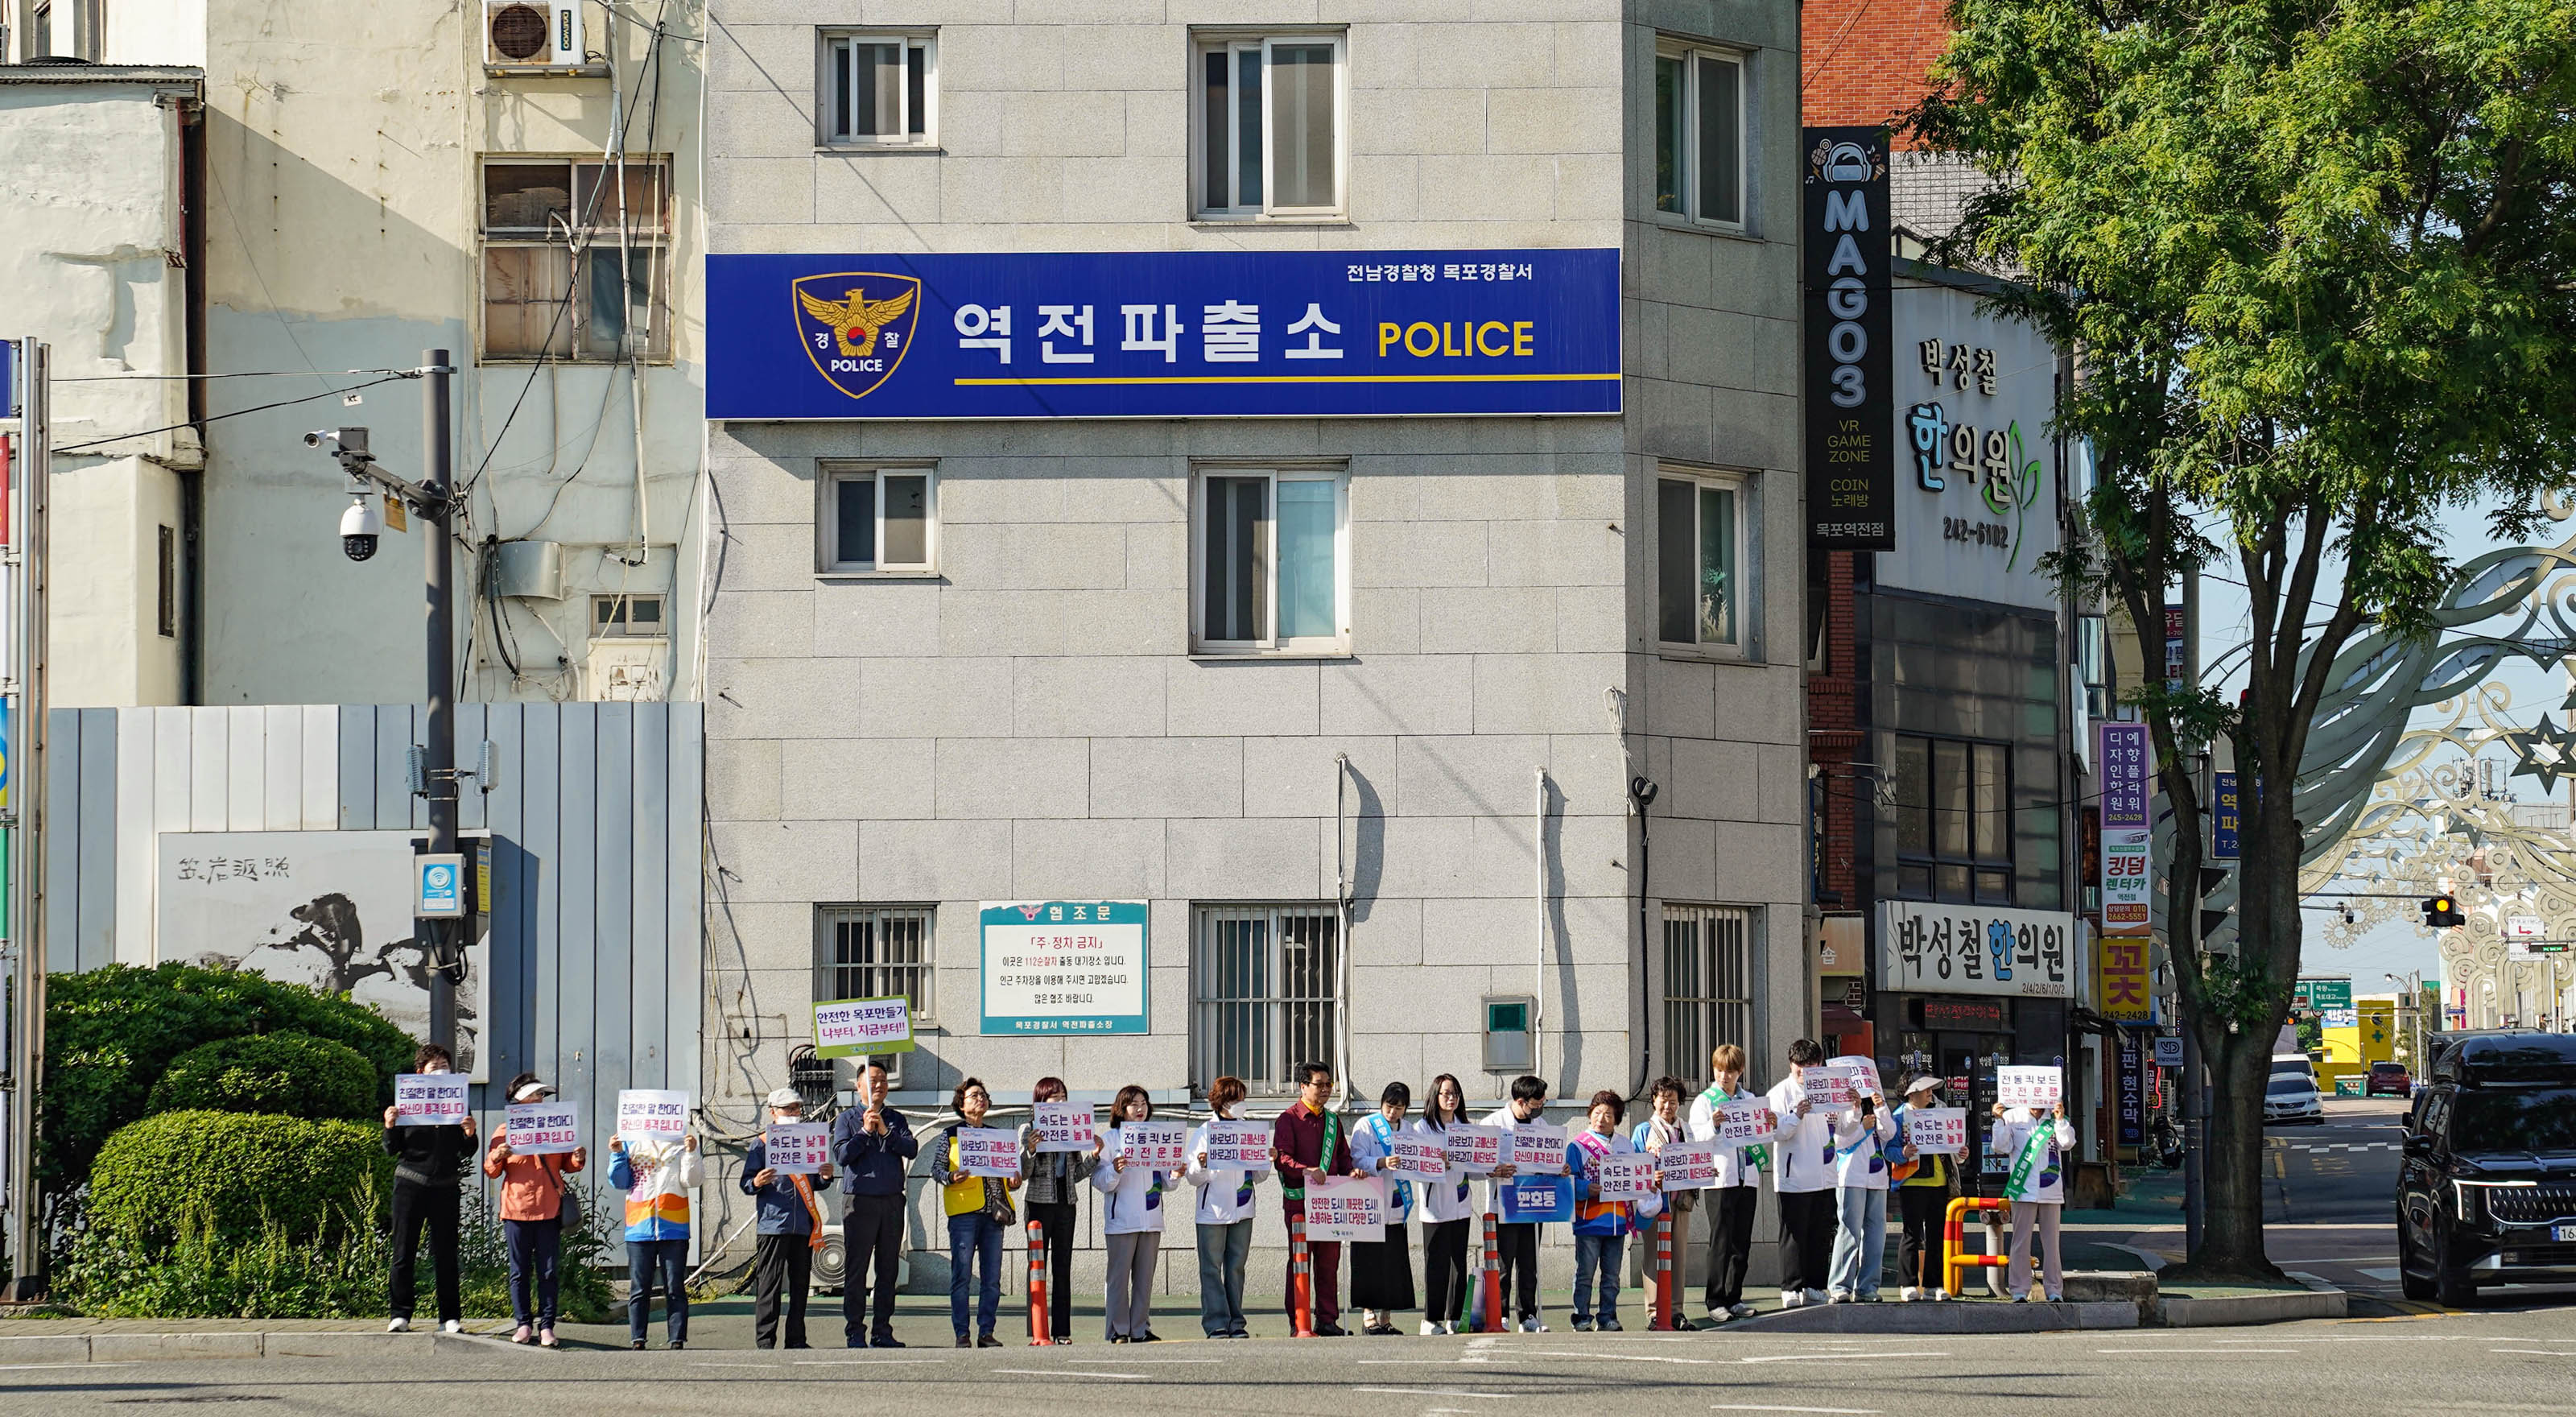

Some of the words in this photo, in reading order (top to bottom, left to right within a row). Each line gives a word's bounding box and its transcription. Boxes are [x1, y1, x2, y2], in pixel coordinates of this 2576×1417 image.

[1347, 264, 1435, 282] 전남경찰청
[1443, 263, 1533, 281] 목포경찰서
[954, 300, 1344, 364] 역전파출소
[1379, 320, 1534, 357] POLICE
[831, 359, 883, 372] POLICE
[1919, 337, 1998, 395] 박성철
[1839, 419, 1860, 432] VR
[1827, 435, 1872, 448] GAME
[1829, 450, 1870, 463] ZONE
[1906, 402, 2012, 503] 한의원
[1831, 478, 1869, 492] COIN
[1831, 494, 1869, 508] 노래방
[1816, 523, 1885, 537] 목포역전점
[1943, 515, 2008, 548] 242-6102
[2109, 732, 2123, 811] 디자인학원
[2107, 813, 2143, 821] 245-2428
[2107, 856, 2146, 876] 킹덤
[2106, 878, 2147, 890] 렌터카
[1049, 906, 1111, 921] 협조문
[1002, 956, 1022, 966] 이곳은
[1025, 956, 1057, 967] 112순찰차
[1059, 956, 1072, 966] 출동
[1075, 956, 1102, 966] 대기장소
[1104, 956, 1126, 965] 입니다.
[1000, 975, 1013, 986] 인근
[1015, 975, 1042, 985] 주차장을
[1043, 975, 1063, 985] 이용해
[1065, 974, 1085, 985] 주시면
[2103, 945, 2145, 1006] 꽃
[2022, 982, 2065, 994] 2/4/2/6/1/0/2
[1034, 994, 1047, 1004] 많은
[1050, 994, 1063, 1004] 협조
[1065, 993, 1094, 1003] 바랍니다.
[816, 1010, 850, 1024] 안전한
[853, 1006, 907, 1021] 목포만들기
[2103, 1010, 2148, 1020] 242-2428
[822, 1026, 856, 1039] 나부터,
[858, 1022, 905, 1036] 지금부터!!
[1015, 1021, 1058, 1030] 목포경찰서
[1062, 1020, 1113, 1029] 역전파출소장
[399, 1087, 426, 1099] 친절한
[427, 1087, 436, 1099] 말
[437, 1087, 463, 1098] 한마디
[399, 1103, 422, 1115] 당신의
[621, 1103, 646, 1115] 친절한
[647, 1103, 656, 1114] 말
[658, 1103, 683, 1114] 한마디
[510, 1117, 535, 1130] 친절한
[537, 1116, 546, 1128] 말
[547, 1114, 573, 1127] 한마디
[1039, 1114, 1068, 1126] 속도는
[1072, 1113, 1091, 1126] 낮게
[1914, 1120, 1942, 1131] 속도는
[1946, 1118, 1963, 1130] 낮게
[1039, 1129, 1069, 1142] 안전은
[1073, 1129, 1092, 1141] 높게
[1125, 1133, 1183, 1144] 전동킥보드
[1725, 1126, 1752, 1138] 안전은
[510, 1133, 533, 1145] 당신의
[770, 1136, 801, 1149] 속도는
[806, 1135, 826, 1147] 낮게
[1210, 1134, 1238, 1144] 바로보자
[1240, 1134, 1266, 1145] 교통신호
[1448, 1136, 1473, 1148] 바로보자
[1475, 1137, 1498, 1149] 교통신호
[1515, 1136, 1535, 1147] 친절한
[1536, 1137, 1543, 1148] 말
[1544, 1137, 1563, 1150] 한마디
[1915, 1134, 1943, 1145] 안전은
[1947, 1133, 1963, 1144] 높게
[961, 1140, 989, 1151] 바로보자
[989, 1140, 1016, 1153] 교통신호
[1395, 1144, 1418, 1156] 바로보자
[770, 1151, 801, 1165] 안전은
[807, 1151, 826, 1163] 높게
[1210, 1149, 1239, 1160] 바로걷자
[1240, 1149, 1266, 1160] 횡단보도
[1447, 1151, 1472, 1162] 바로걷자
[1473, 1151, 1496, 1163] 횡단보도
[1514, 1151, 1533, 1162] 당신의
[1664, 1155, 1688, 1167] 바로보자
[1689, 1152, 1712, 1165] 교통신호
[991, 1155, 1018, 1168] 횡단보도
[1419, 1160, 1443, 1173] 횡단보도
[1604, 1166, 1631, 1177] 속도는
[1635, 1164, 1652, 1175] 낮게
[1604, 1179, 1631, 1192] 안전은
[1635, 1179, 1652, 1191] 높게
[1311, 1197, 1330, 1210] 안전한
[1331, 1198, 1345, 1211] 도시!
[1346, 1198, 1364, 1210] 깨끗한
[1364, 1199, 1378, 1211] 도시!
[1517, 1191, 1556, 1208] 만호동
[1309, 1212, 1333, 1224] 소통하는
[1334, 1213, 1348, 1225] 도시!
[1348, 1213, 1367, 1225] 다정한
[1368, 1213, 1381, 1225] 도시!
